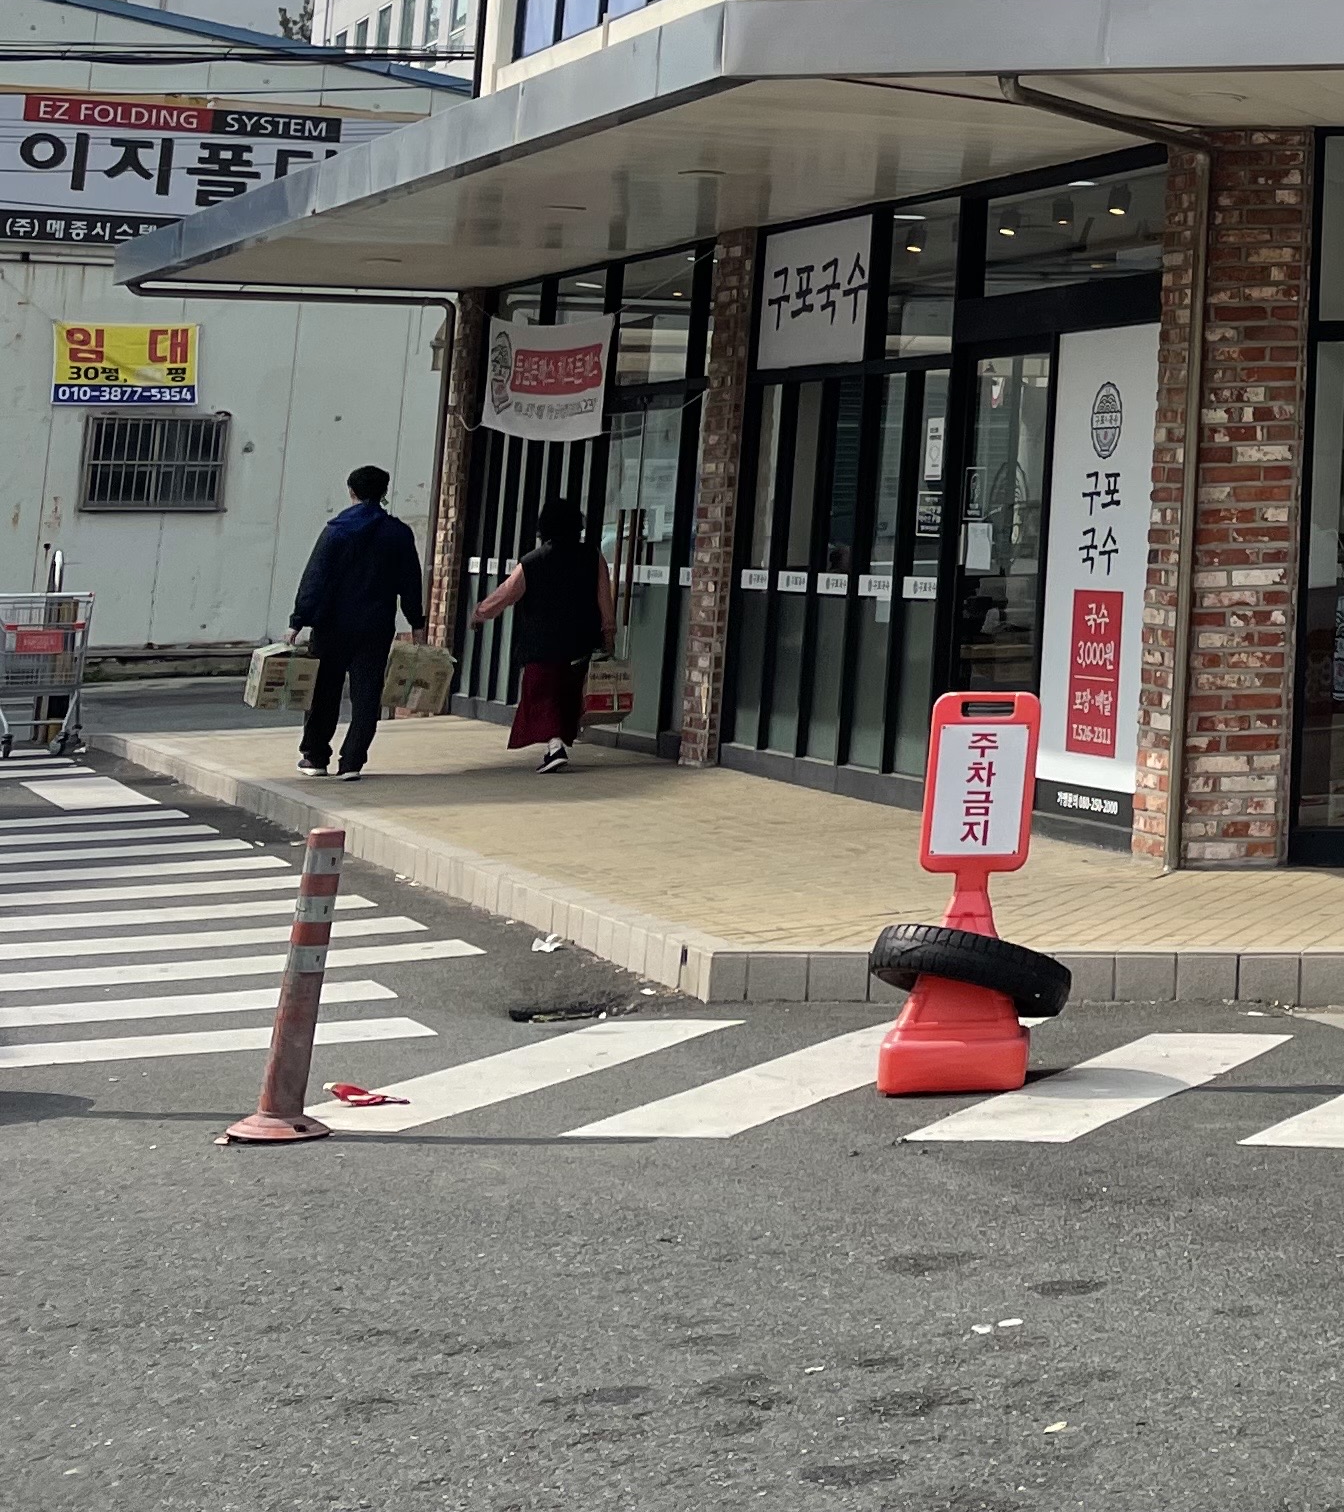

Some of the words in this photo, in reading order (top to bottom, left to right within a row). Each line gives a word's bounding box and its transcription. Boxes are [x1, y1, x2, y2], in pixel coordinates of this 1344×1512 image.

[38, 100, 70, 121] EZ
[79, 102, 199, 130] FOLDING
[224, 113, 328, 138] SYSTEM
[19, 131, 339, 208] 이지폴
[767, 251, 869, 332] 구포국수
[57, 385, 192, 402] 010-3877-5354
[166, 367, 187, 383] 평
[1082, 471, 1121, 516] 구포
[1079, 526, 1119, 576] 국수
[1084, 602, 1110, 635] 국수
[1076, 640, 1115, 671] 3,000원
[959, 732, 999, 847] 주차금지
